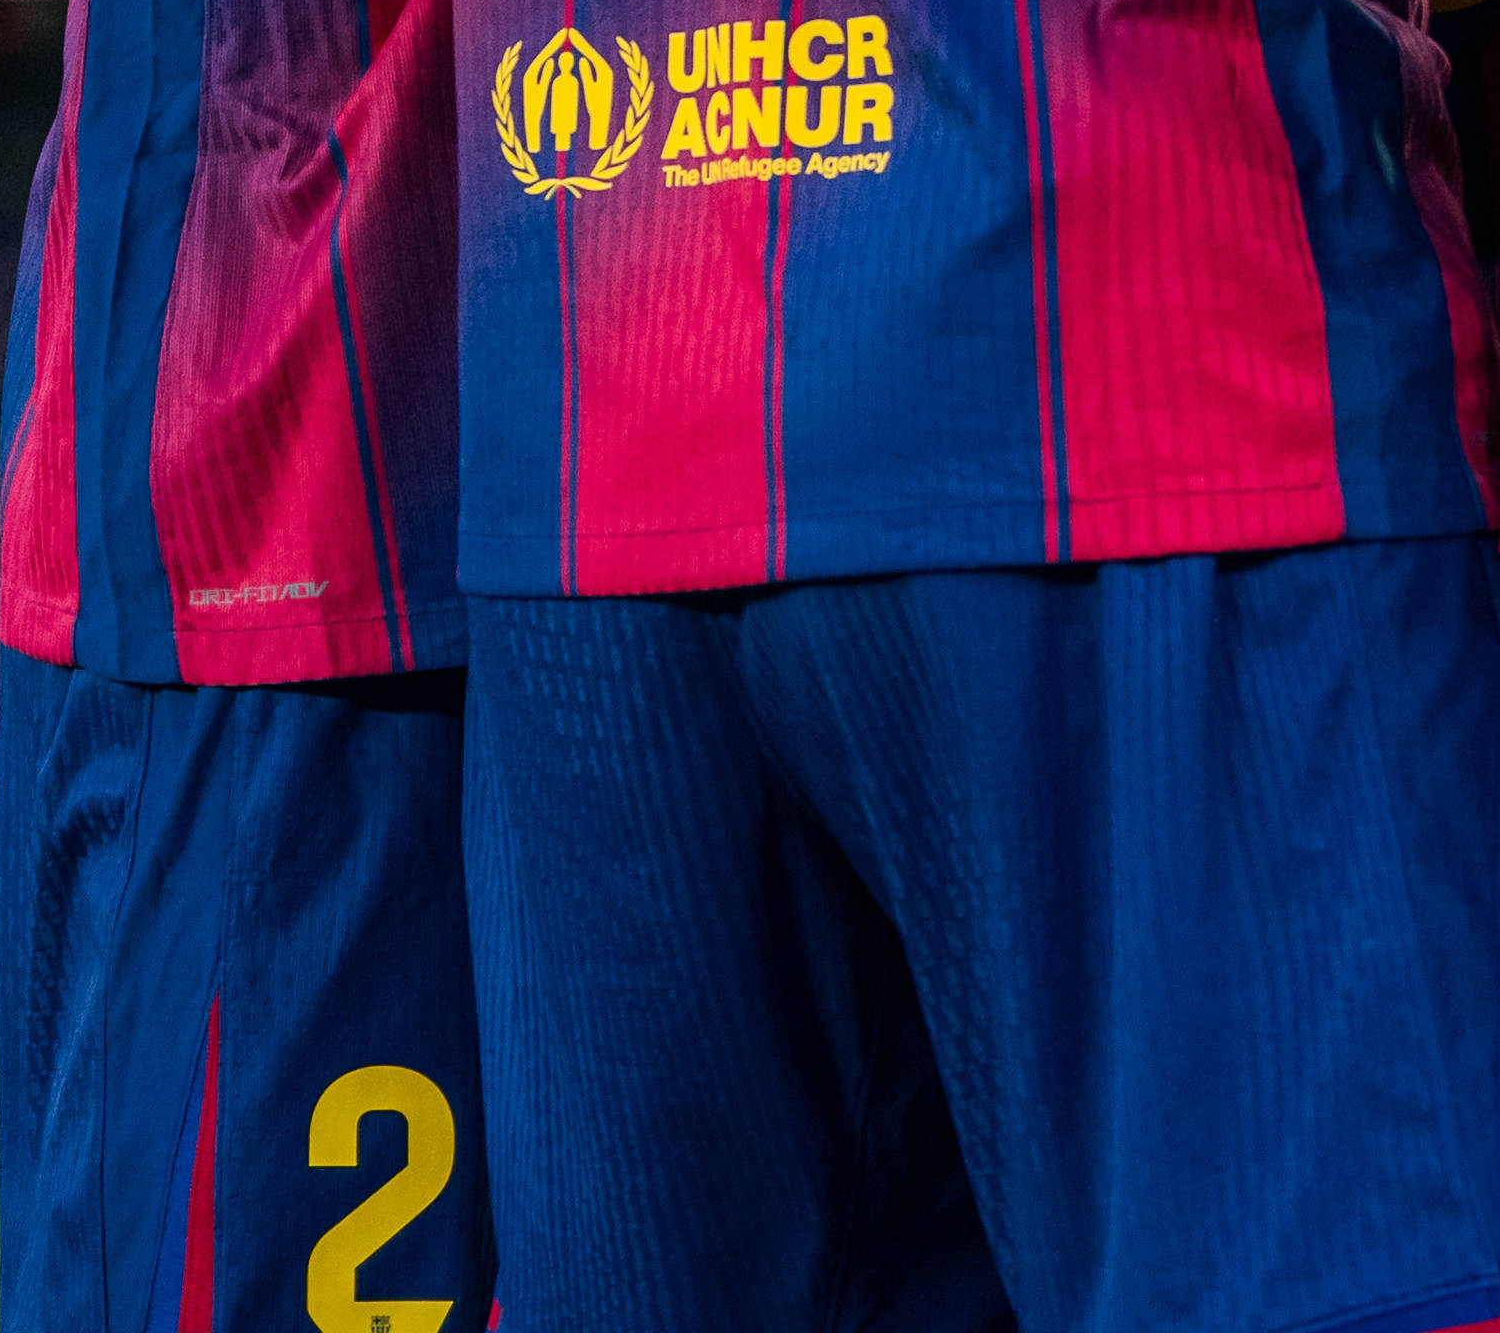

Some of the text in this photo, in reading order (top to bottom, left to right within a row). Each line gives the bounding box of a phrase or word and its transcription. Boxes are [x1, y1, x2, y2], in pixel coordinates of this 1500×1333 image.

[667, 14, 894, 94] UNHCR
[661, 82, 895, 160] ACNUR
[662, 164, 700, 188] The
[805, 151, 891, 180] Agency
[306, 1064, 456, 1333] 2
